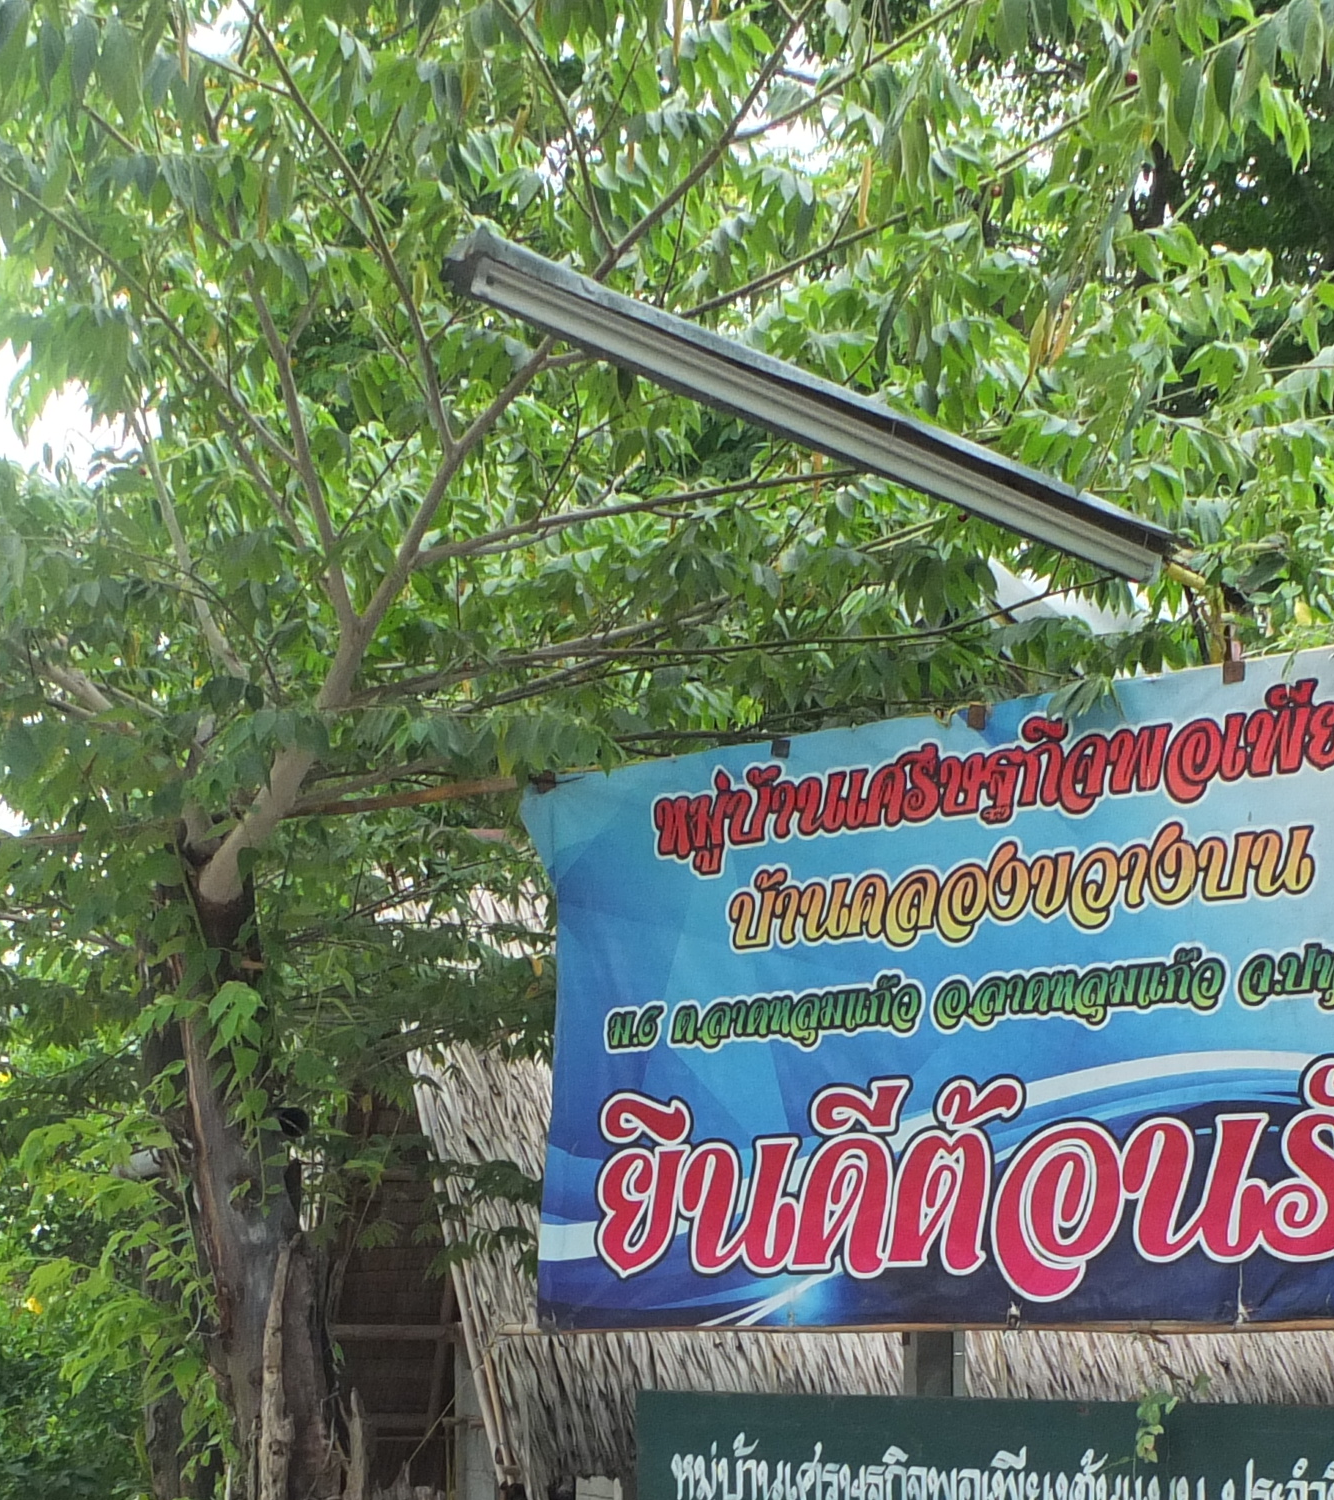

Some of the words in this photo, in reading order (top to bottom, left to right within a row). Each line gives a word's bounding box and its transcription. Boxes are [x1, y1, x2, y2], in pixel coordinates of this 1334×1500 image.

[729, 822, 1315, 950] บ้านคลองขวางบน
